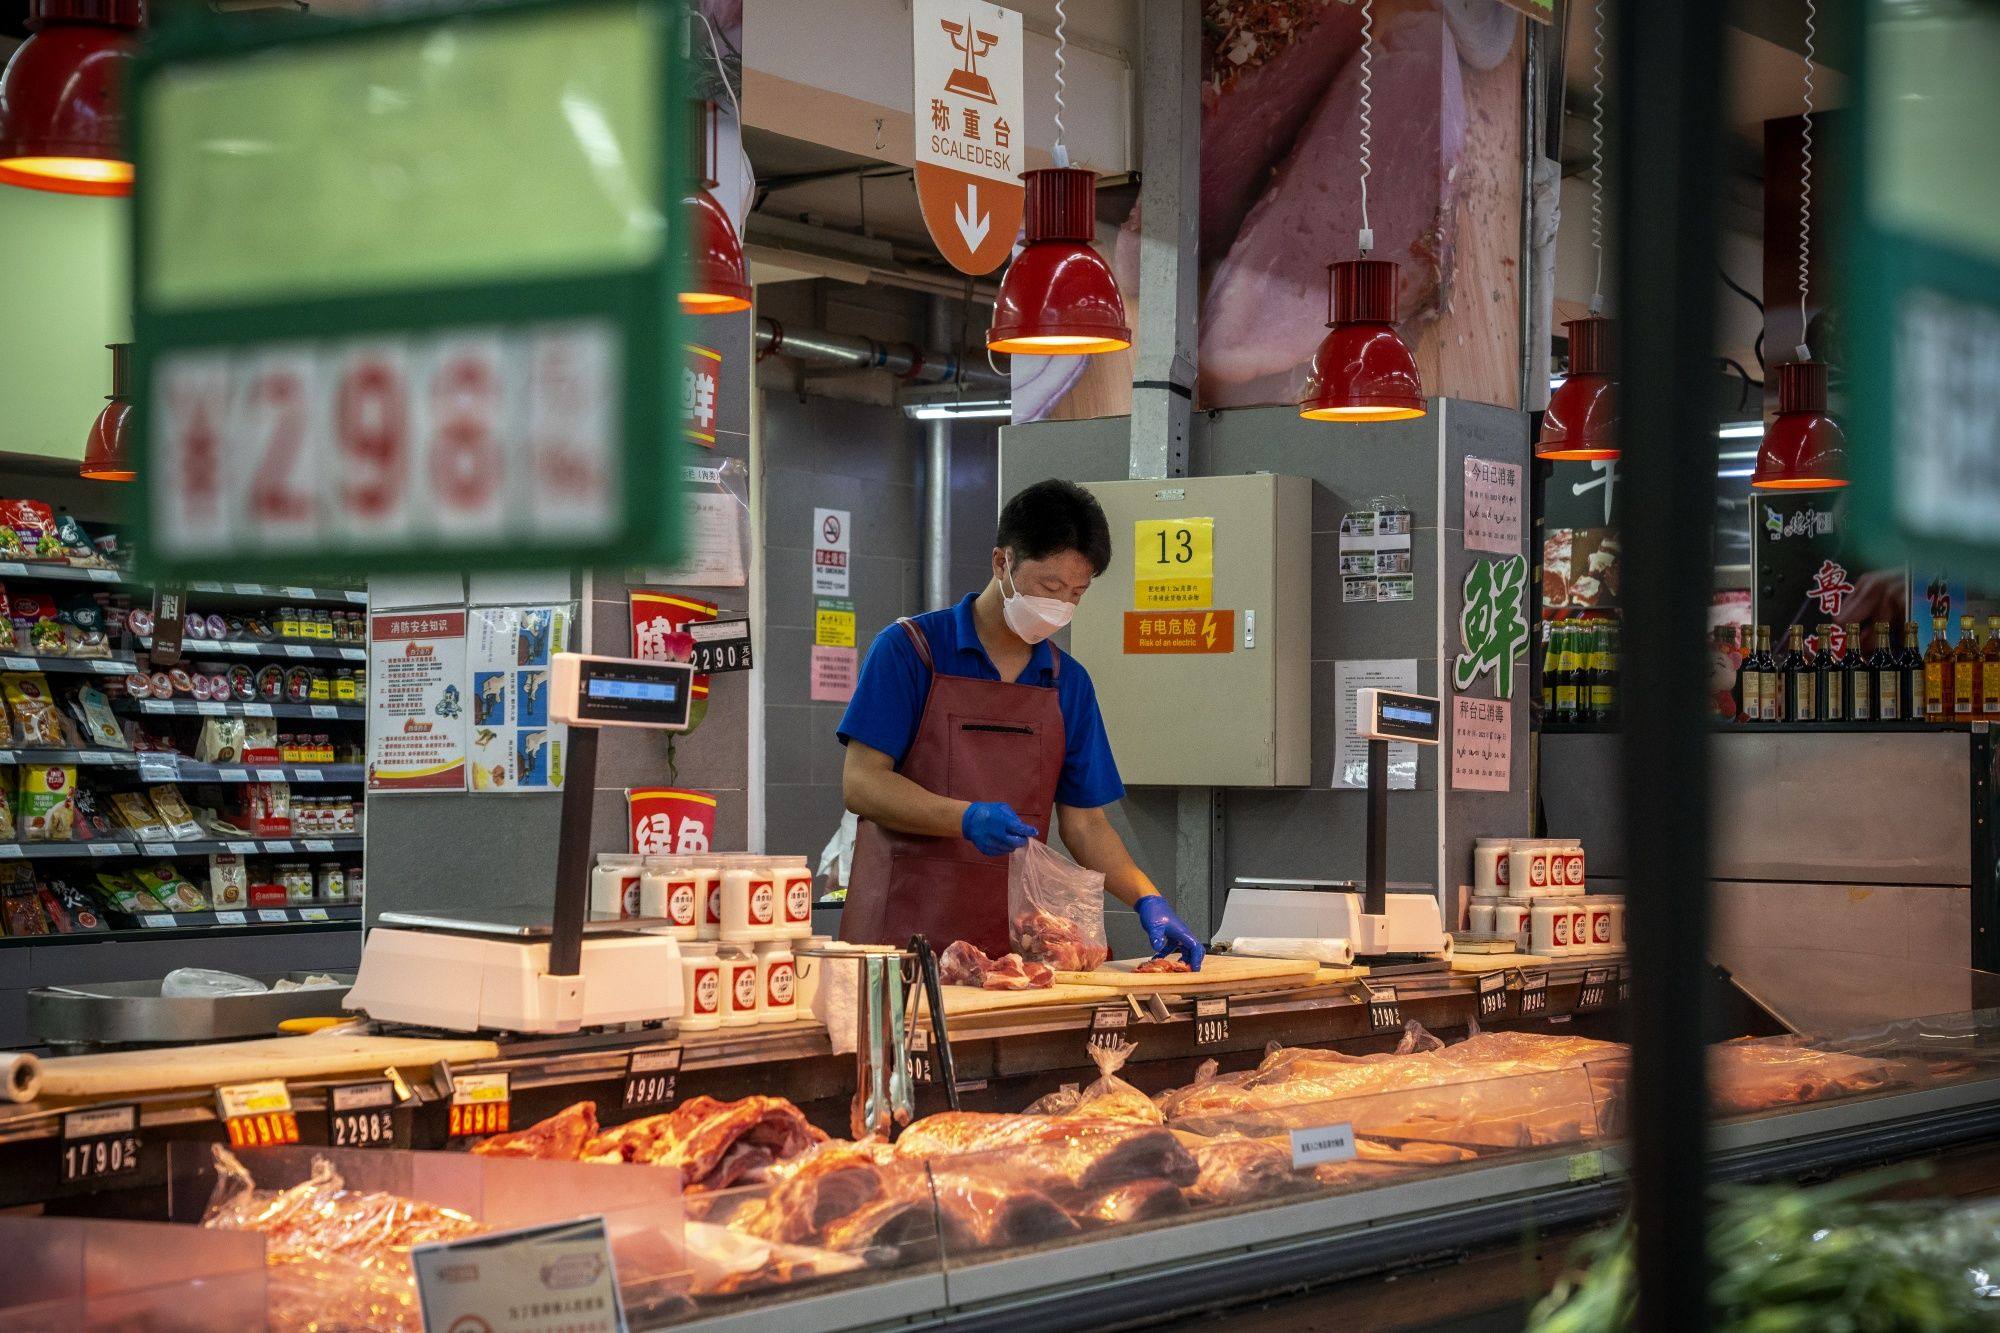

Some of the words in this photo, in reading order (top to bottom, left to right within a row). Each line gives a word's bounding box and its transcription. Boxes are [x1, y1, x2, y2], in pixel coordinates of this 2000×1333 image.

[931, 98, 1011, 149] 称重台
[931, 134, 1011, 172] SCALEDESK
[1472, 463, 1516, 487] 今日已消毒
[1157, 529, 1193, 564] 13
[390, 619, 448, 634] 消防安全知识
[1139, 618, 1197, 636] 有电危险
[1139, 638, 1153, 647] Risk
[1154, 638, 1162, 647] of
[1171, 638, 1197, 647] electric
[1454, 554, 1528, 698] 鲜
[635, 813, 709, 854] 绿色
